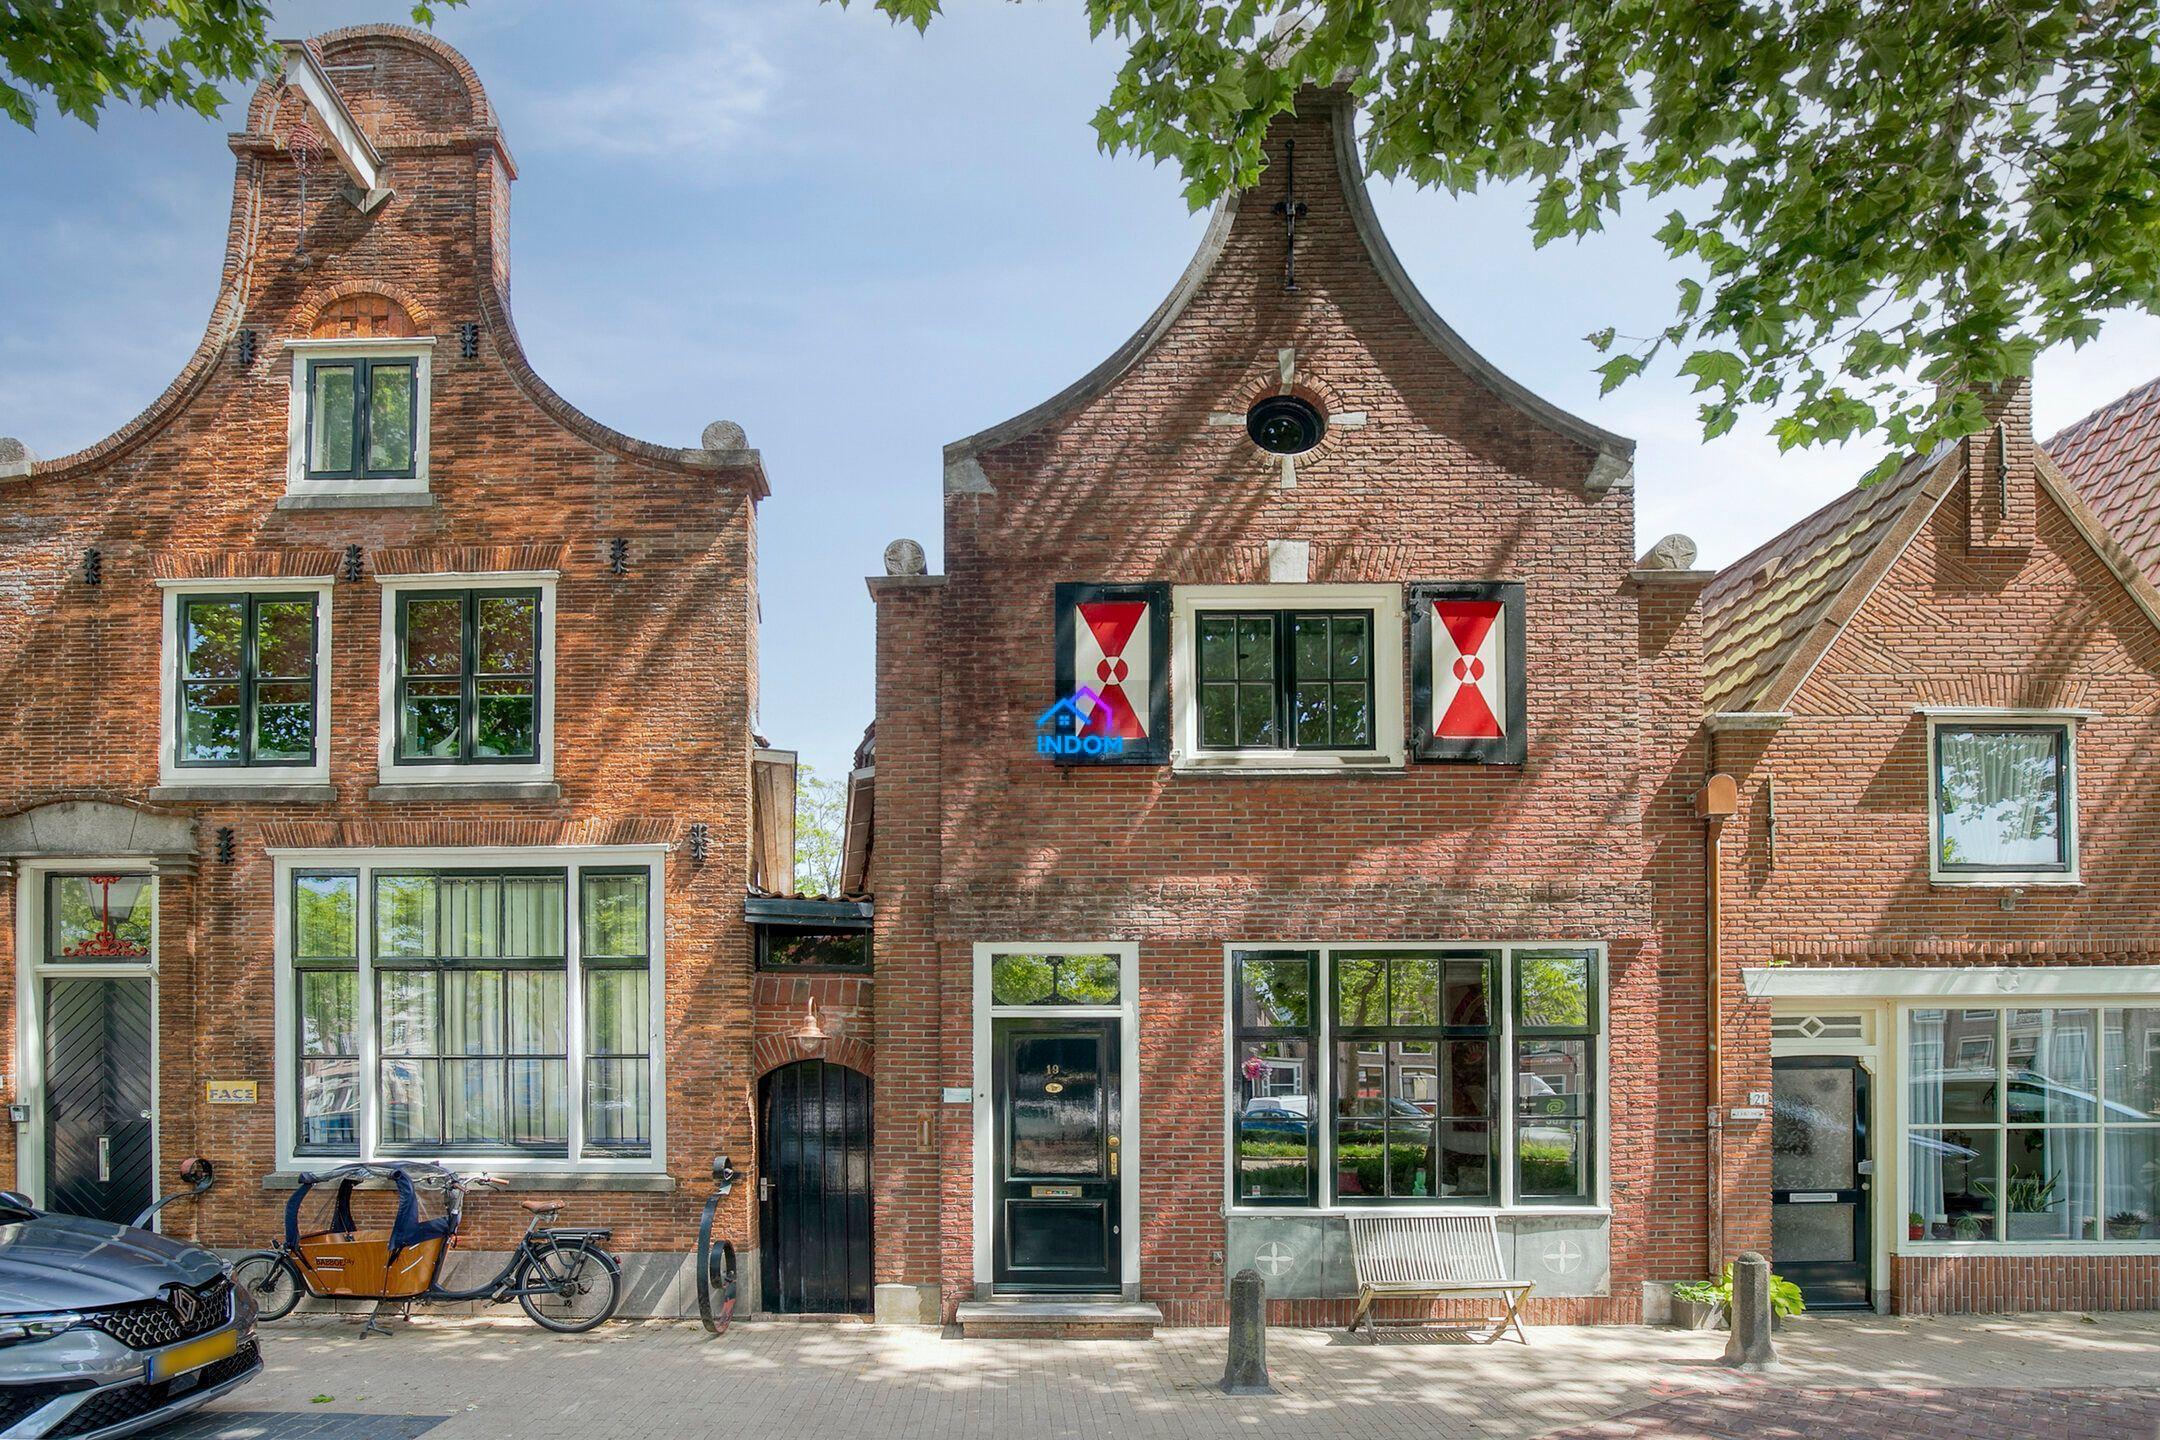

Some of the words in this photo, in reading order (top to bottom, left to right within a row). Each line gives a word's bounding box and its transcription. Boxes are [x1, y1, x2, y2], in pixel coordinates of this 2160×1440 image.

[1046, 1064, 1059, 1075] 19
[209, 1089, 254, 1099] FACE
[1754, 1094, 1765, 1104] 21
